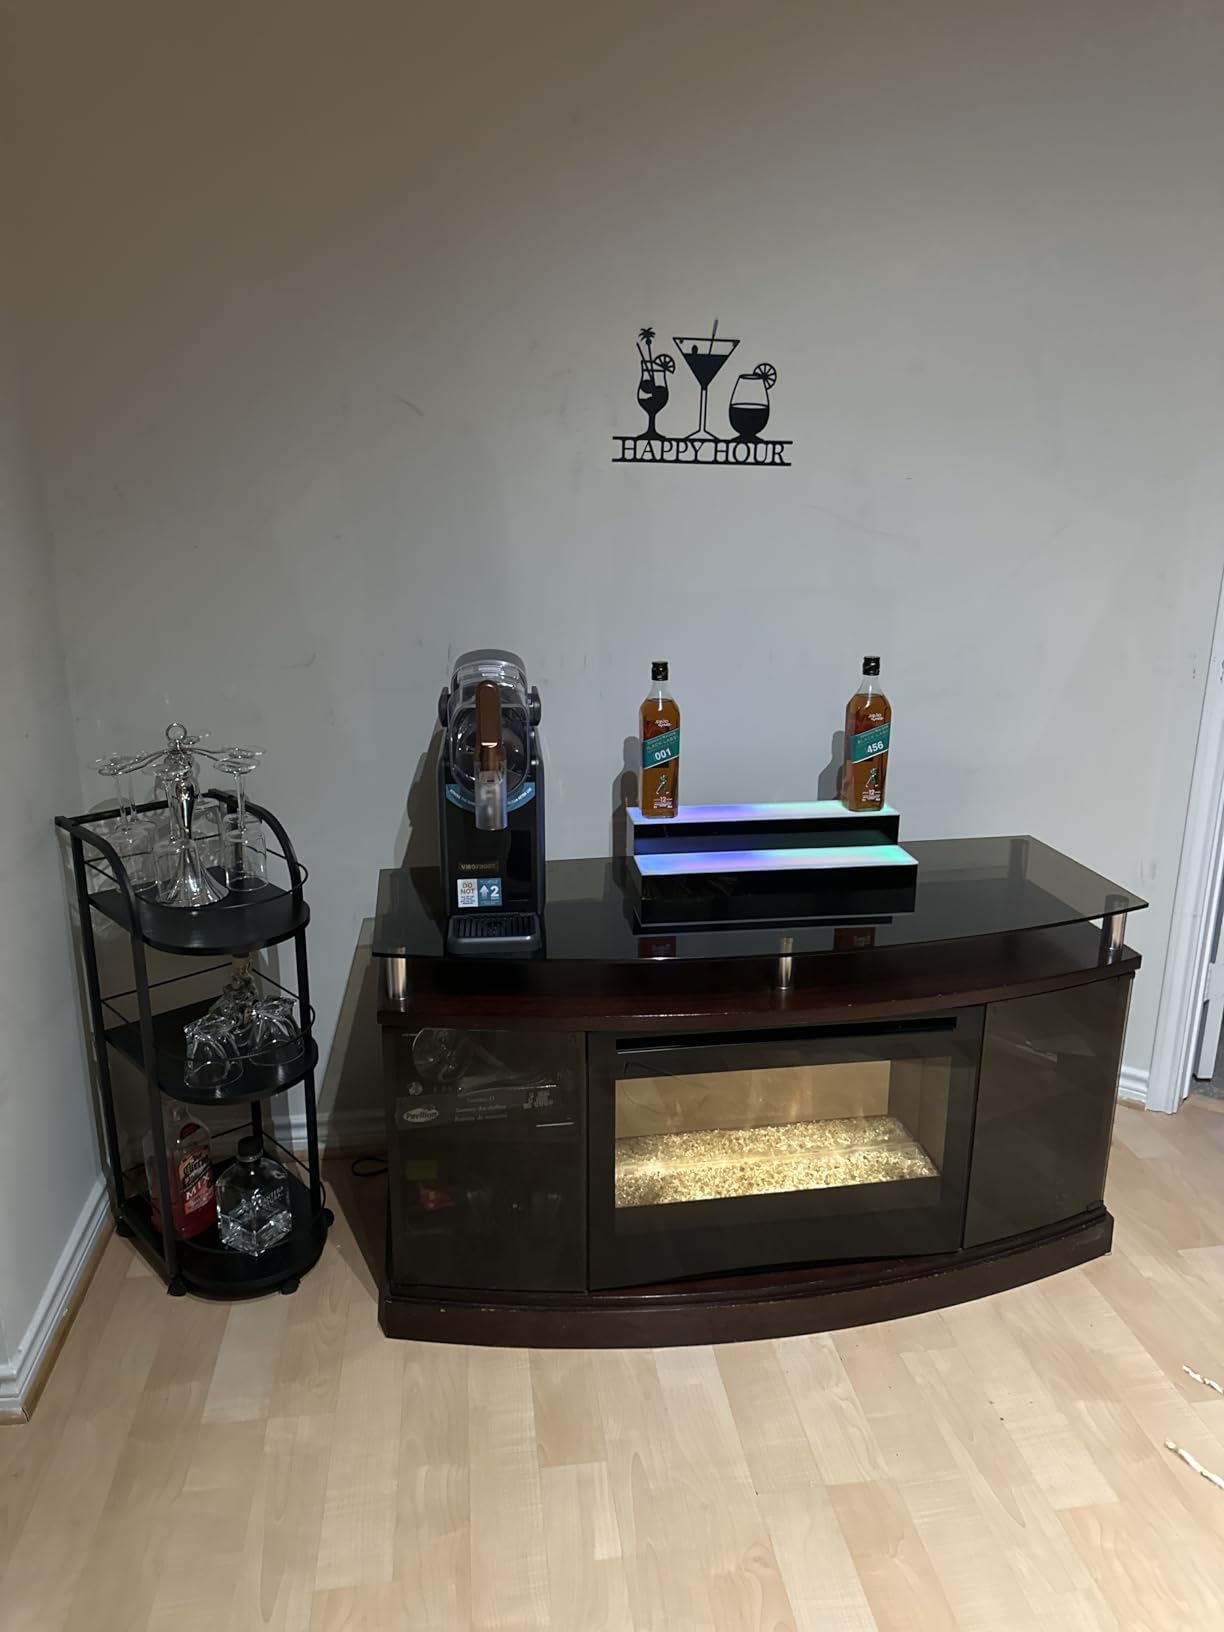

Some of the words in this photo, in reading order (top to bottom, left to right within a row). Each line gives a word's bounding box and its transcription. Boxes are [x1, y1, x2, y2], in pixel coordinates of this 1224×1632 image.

[621, 439, 704, 462] HAPPY
[714, 441, 785, 463] HOUR
[867, 741, 884, 753] 456
[655, 748, 671, 760] 001
[490, 885, 500, 897] 2
[186, 1172, 210, 1201] MIX
